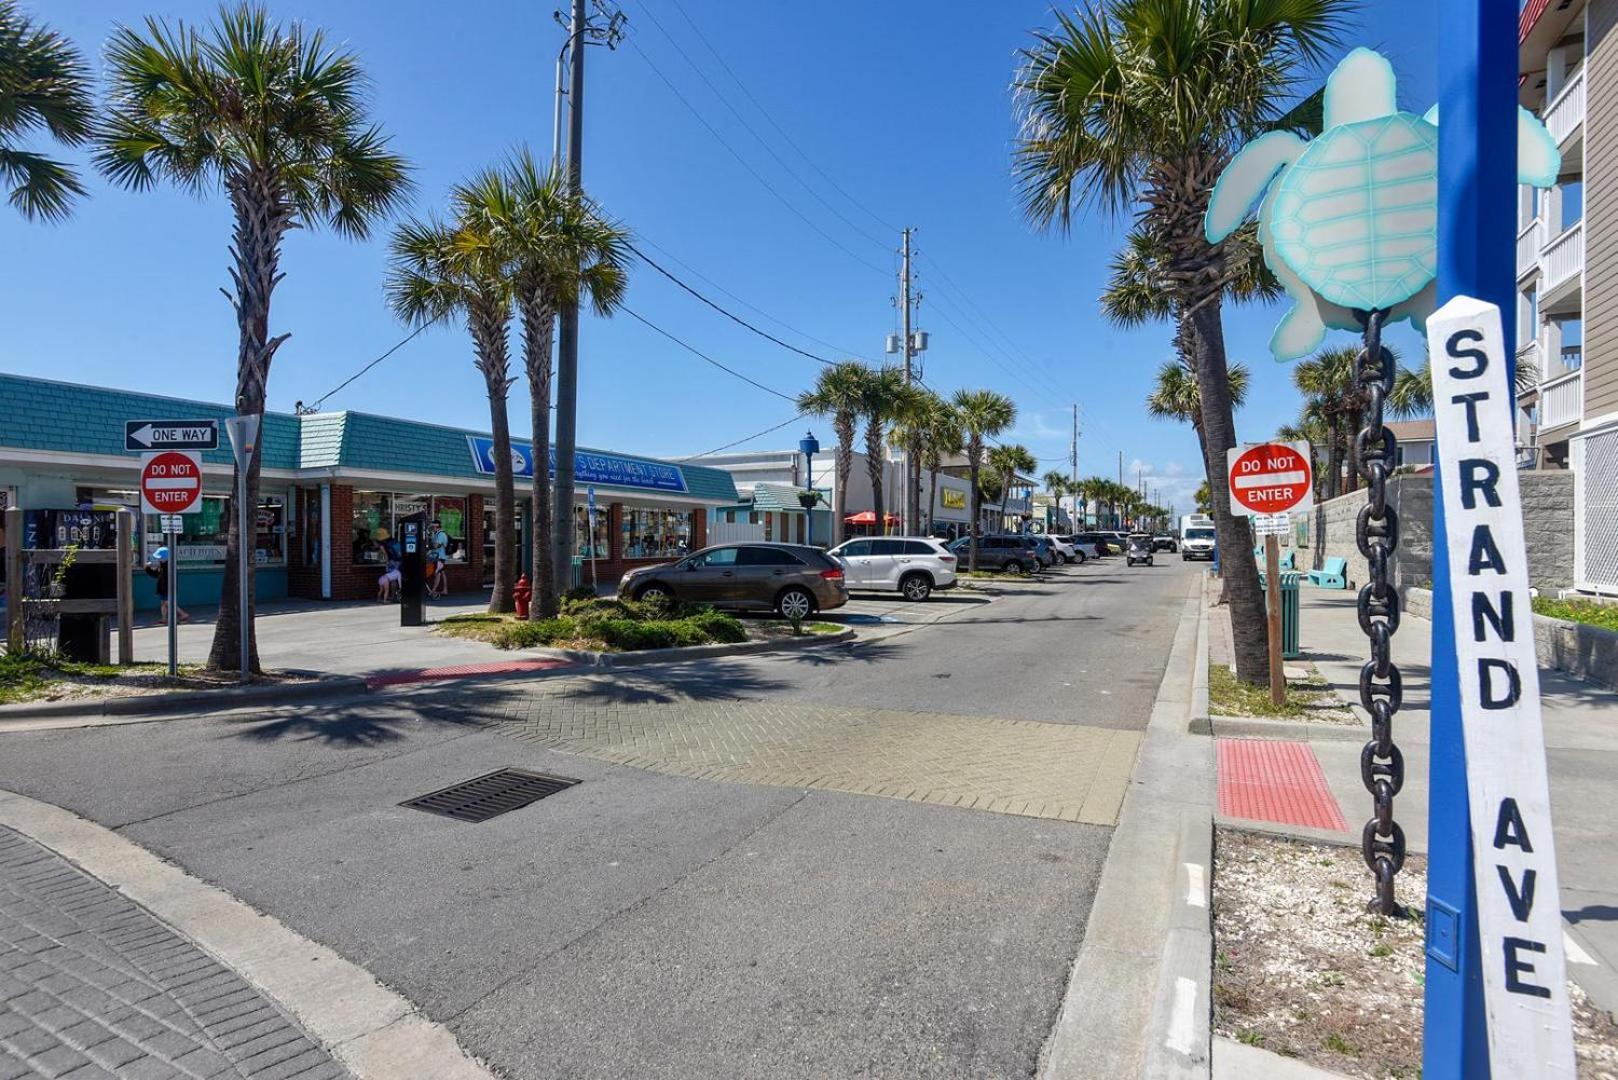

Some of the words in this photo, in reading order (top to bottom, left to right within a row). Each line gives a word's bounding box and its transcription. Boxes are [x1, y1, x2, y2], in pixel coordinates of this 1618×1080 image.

[152, 429, 178, 441] ONE
[182, 429, 208, 441] WAY
[151, 464, 166, 475] DO
[170, 464, 192, 475] NOT
[587, 457, 648, 475] DEPARTMENT
[1241, 460, 1260, 473] DO
[1267, 456, 1295, 470] NOT
[154, 491, 189, 502] ENTER
[1247, 487, 1293, 502] ENTER
[1446, 329, 1522, 710] STRAND
[1493, 797, 1552, 999] AVE
